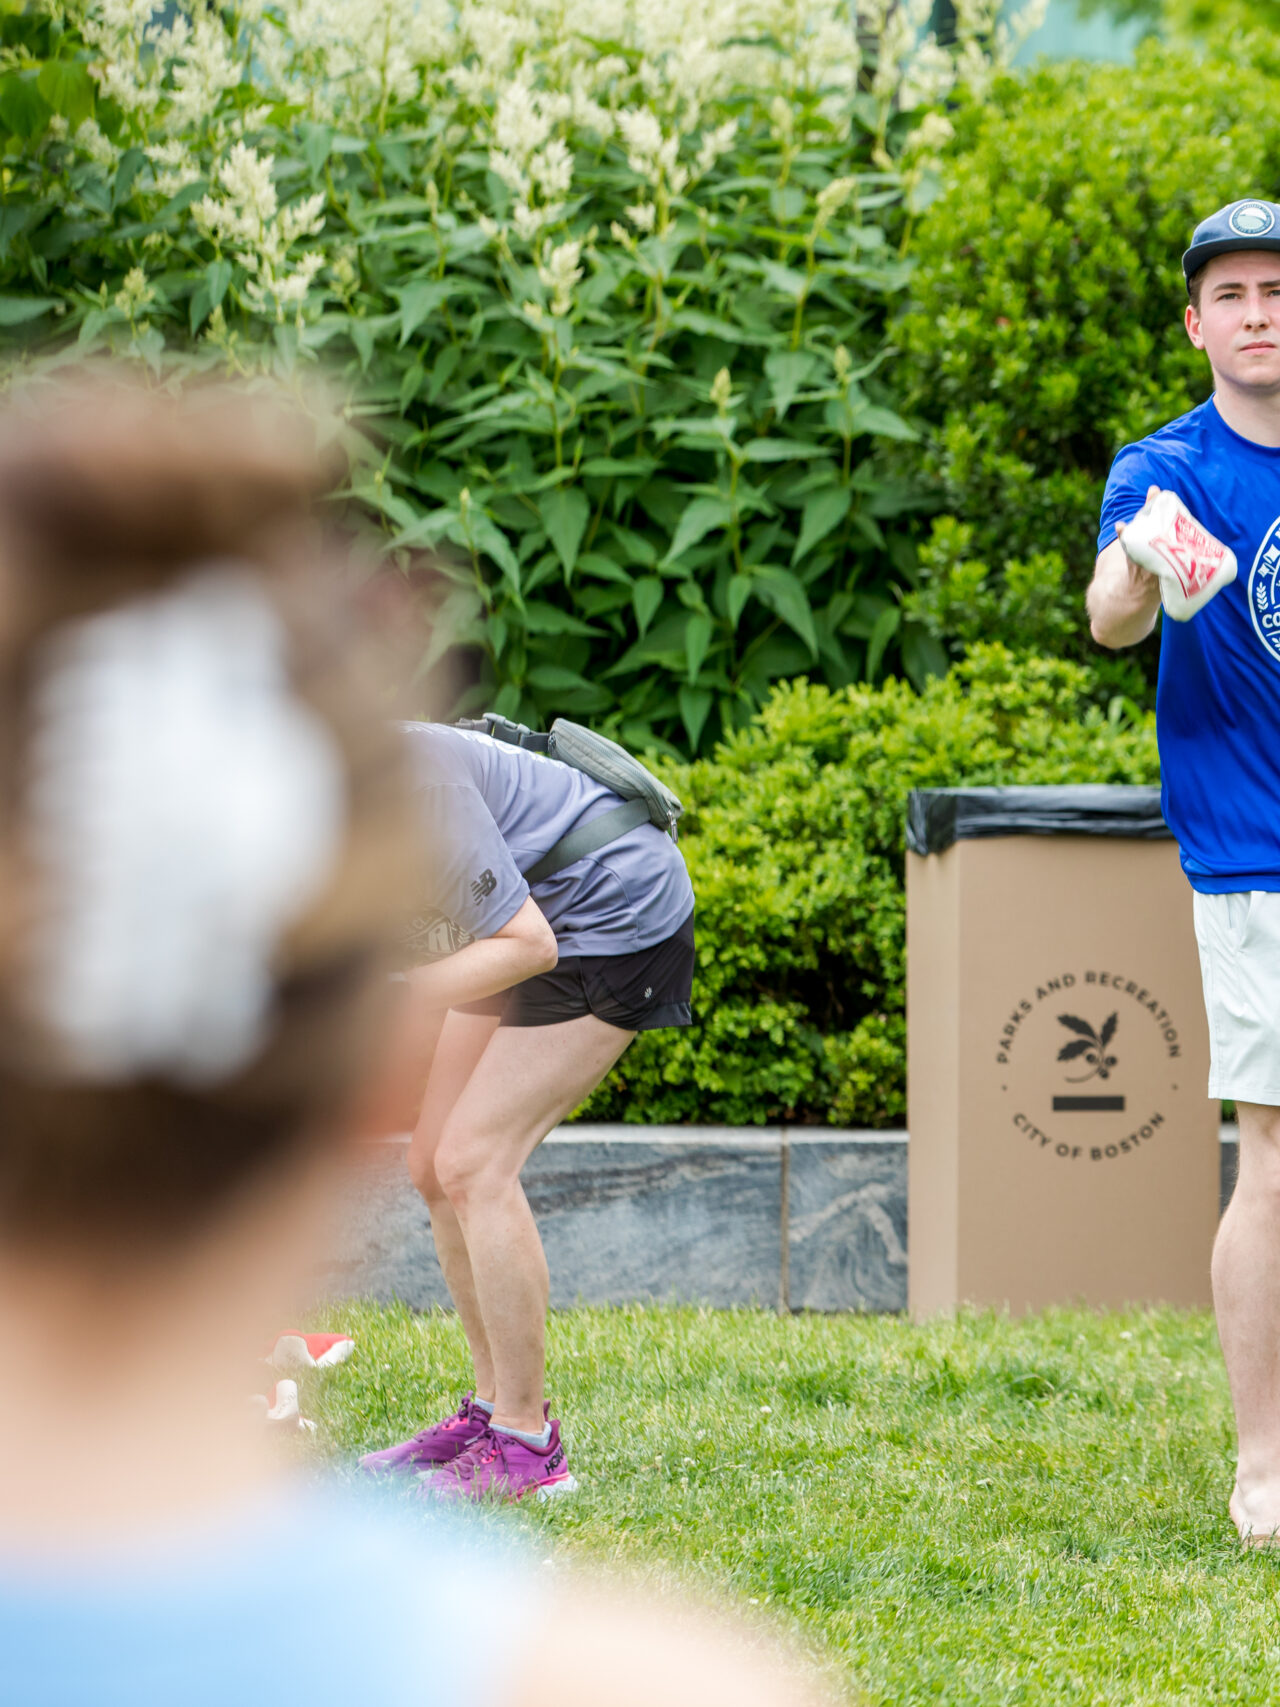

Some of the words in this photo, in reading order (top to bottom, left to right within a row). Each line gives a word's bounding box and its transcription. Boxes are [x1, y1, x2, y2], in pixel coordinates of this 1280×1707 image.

[997, 999, 1033, 1064] PARKS
[1035, 973, 1076, 1001] AND
[1085, 971, 1181, 1059] RECREATION
[1013, 1113, 1051, 1148] CITY
[1056, 1143, 1082, 1160] OF
[1091, 1112, 1165, 1161] BOSTON
